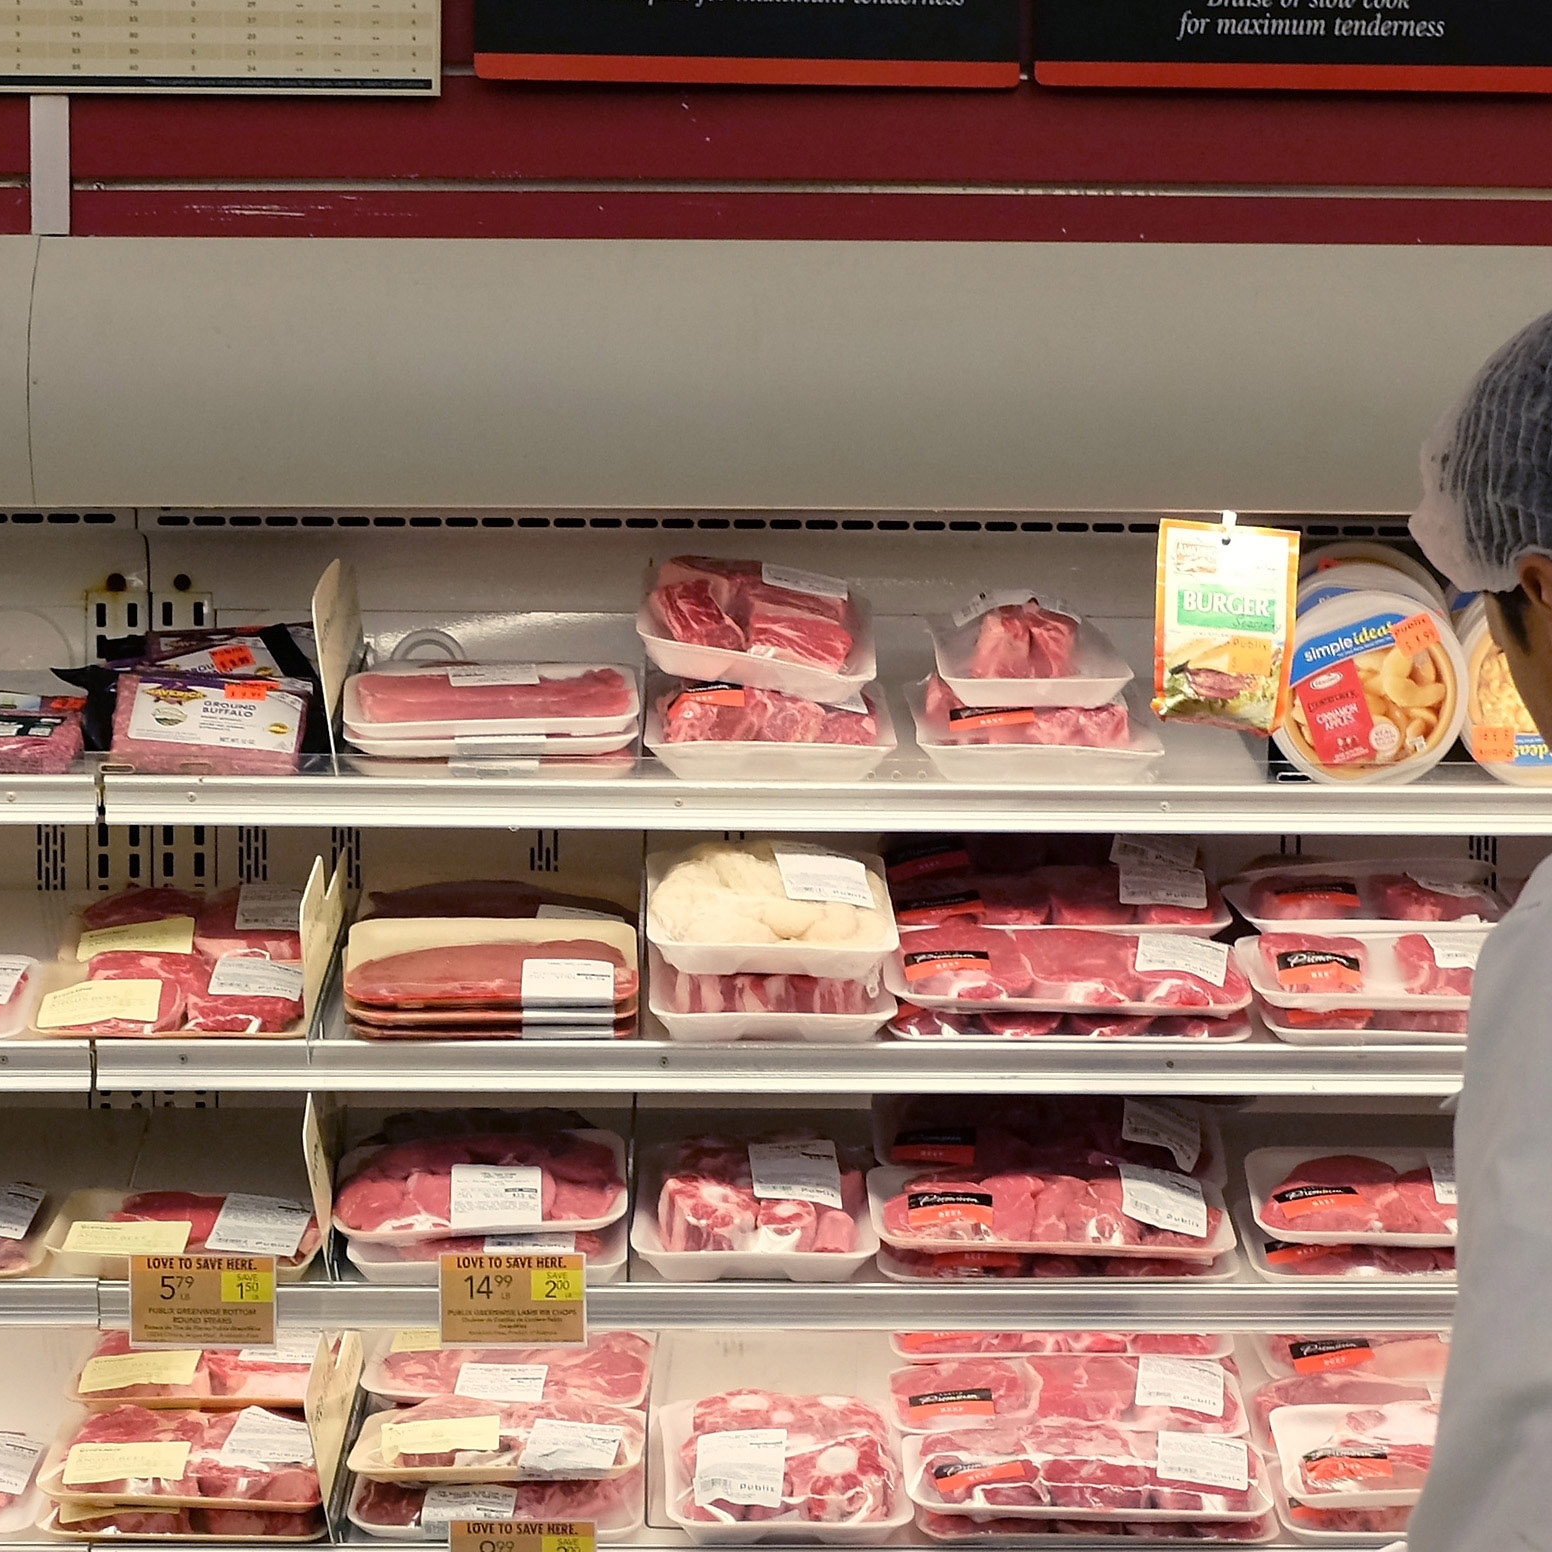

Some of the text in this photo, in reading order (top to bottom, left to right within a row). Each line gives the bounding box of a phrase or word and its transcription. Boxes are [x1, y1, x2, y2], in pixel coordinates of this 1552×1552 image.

[1176, 11, 1446, 41] for maximum tenderness
[1183, 590, 1271, 617] BURGER
[1304, 635, 1353, 663] simple
[203, 700, 257, 711] GROUND
[202, 707, 254, 718] BUFFALO
[147, 1257, 258, 1270] LOVE TO SAVE HERE.
[457, 1256, 567, 1269] LOVE TO SAVE HERE.
[236, 1273, 258, 1281] SAVE
[740, 1483, 776, 1493] Publix
[467, 1523, 579, 1535] LOVE TO SAVE HERE.
